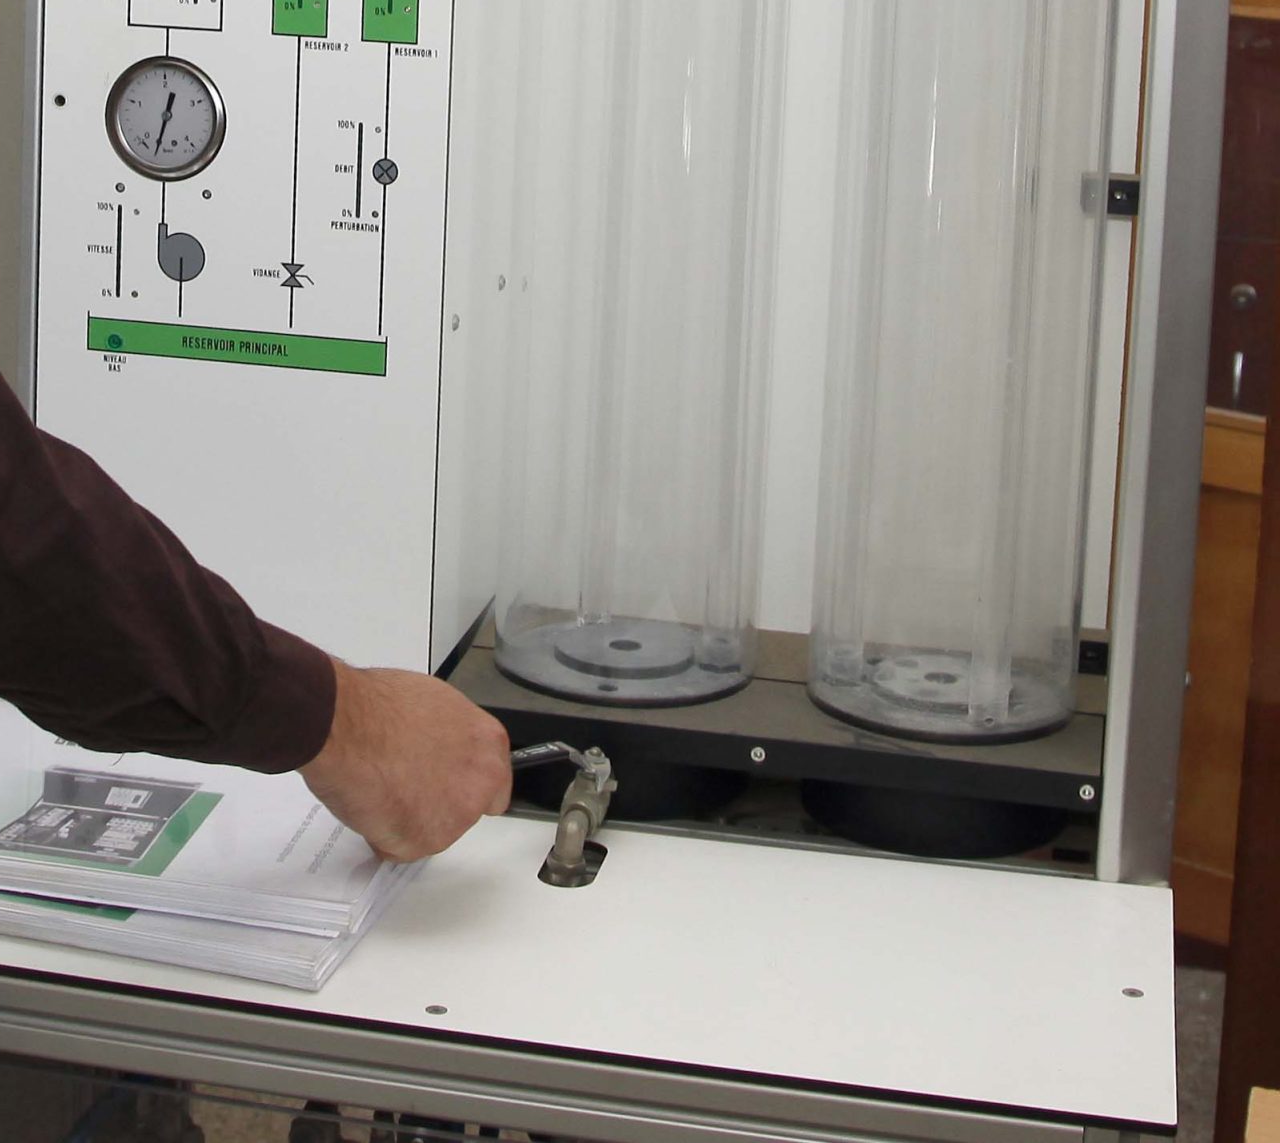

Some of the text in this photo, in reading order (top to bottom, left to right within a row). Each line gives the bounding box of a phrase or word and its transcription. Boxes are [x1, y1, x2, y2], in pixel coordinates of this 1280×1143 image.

[284, 2, 295, 10] 0%
[375, 7, 386, 16] 0%
[304, 40, 342, 52] RESERVOIR
[394, 47, 432, 58] RESERVOIR
[337, 120, 355, 129] 100%
[335, 164, 354, 173] DEBIT
[97, 201, 114, 211] 100%
[342, 209, 353, 217] 0%
[330, 220, 380, 233] PERTURBATION
[87, 244, 113, 254] VITESSE
[253, 268, 280, 278] VIDANGE
[101, 288, 112, 297] 0%
[182, 335, 289, 357] RESERVOIR PRINCIPAL
[103, 355, 127, 364] NIVEAU
[108, 363, 121, 372] BAS
